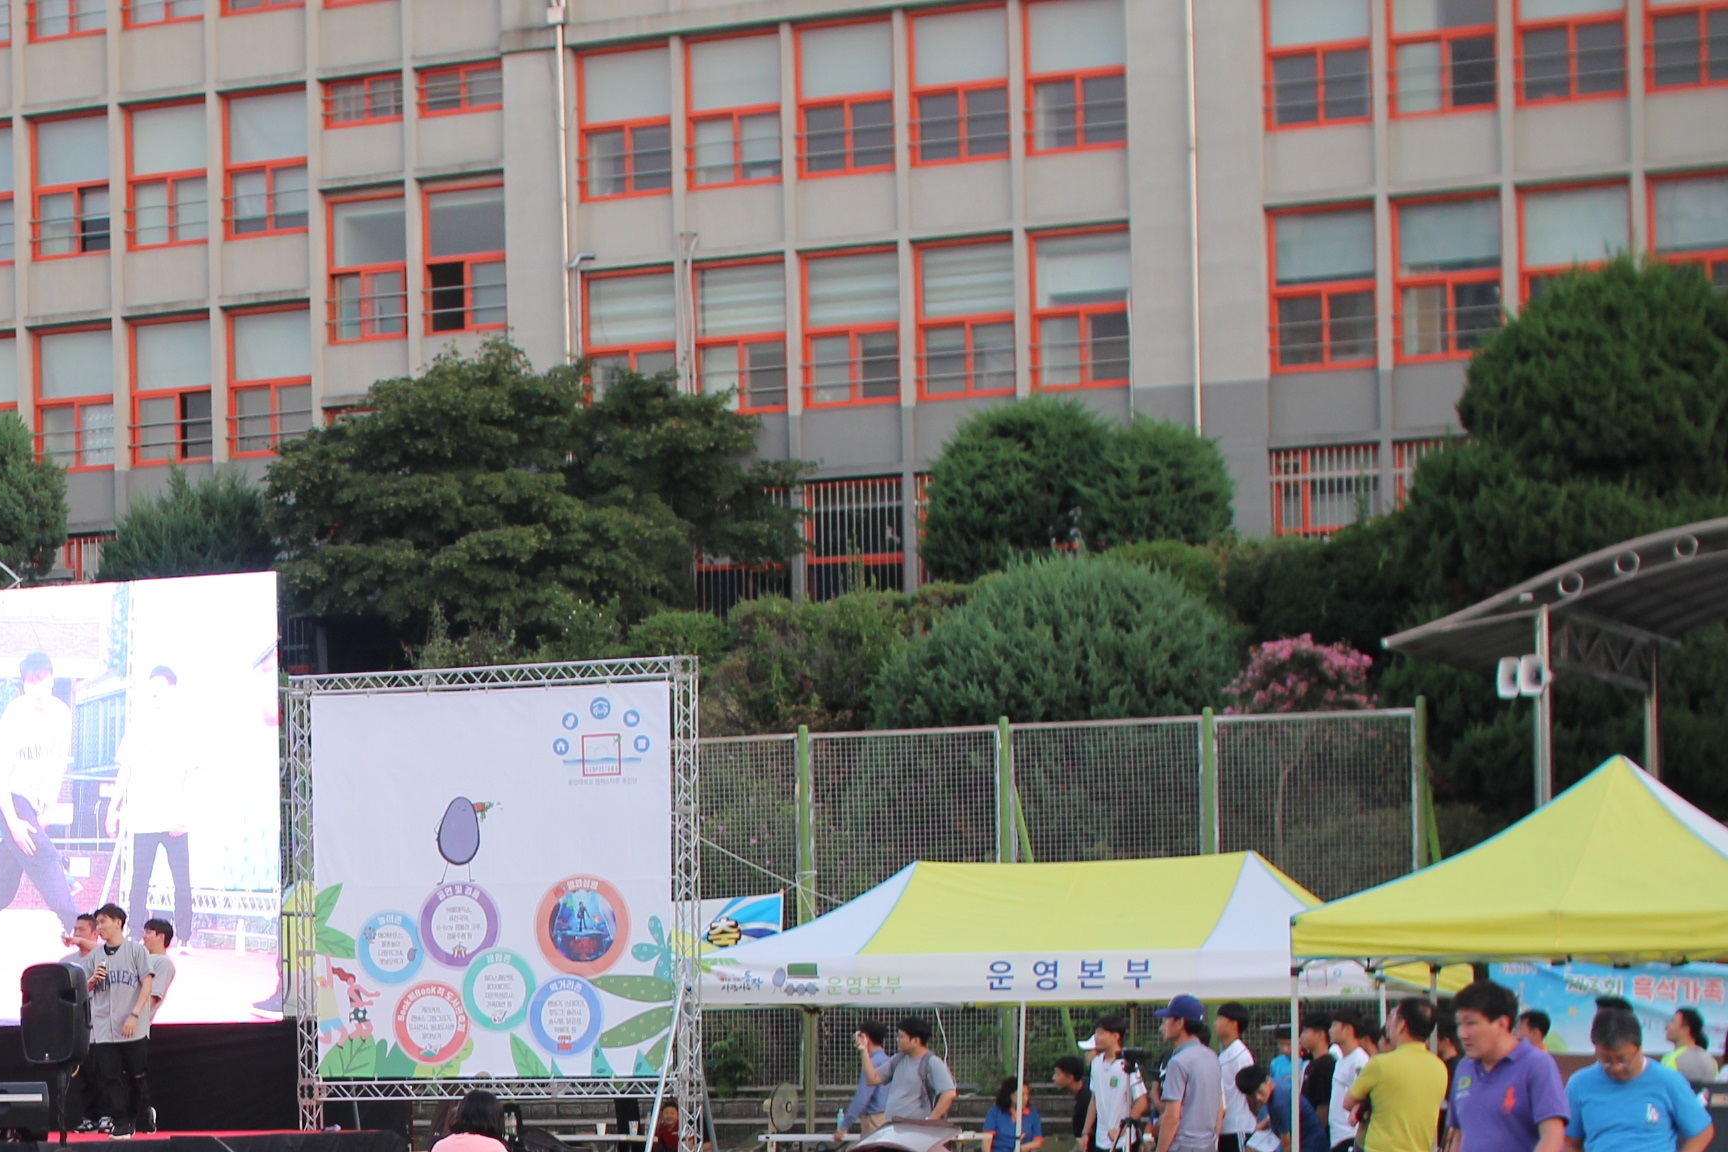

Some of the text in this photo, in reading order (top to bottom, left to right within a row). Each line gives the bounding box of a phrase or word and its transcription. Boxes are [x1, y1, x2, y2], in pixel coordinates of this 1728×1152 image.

[549, 979, 583, 993] 먹거리존
[825, 976, 903, 996] 운영본부
[986, 959, 1152, 991] 운영본부
[1633, 975, 1726, 1003] 흑석가족
